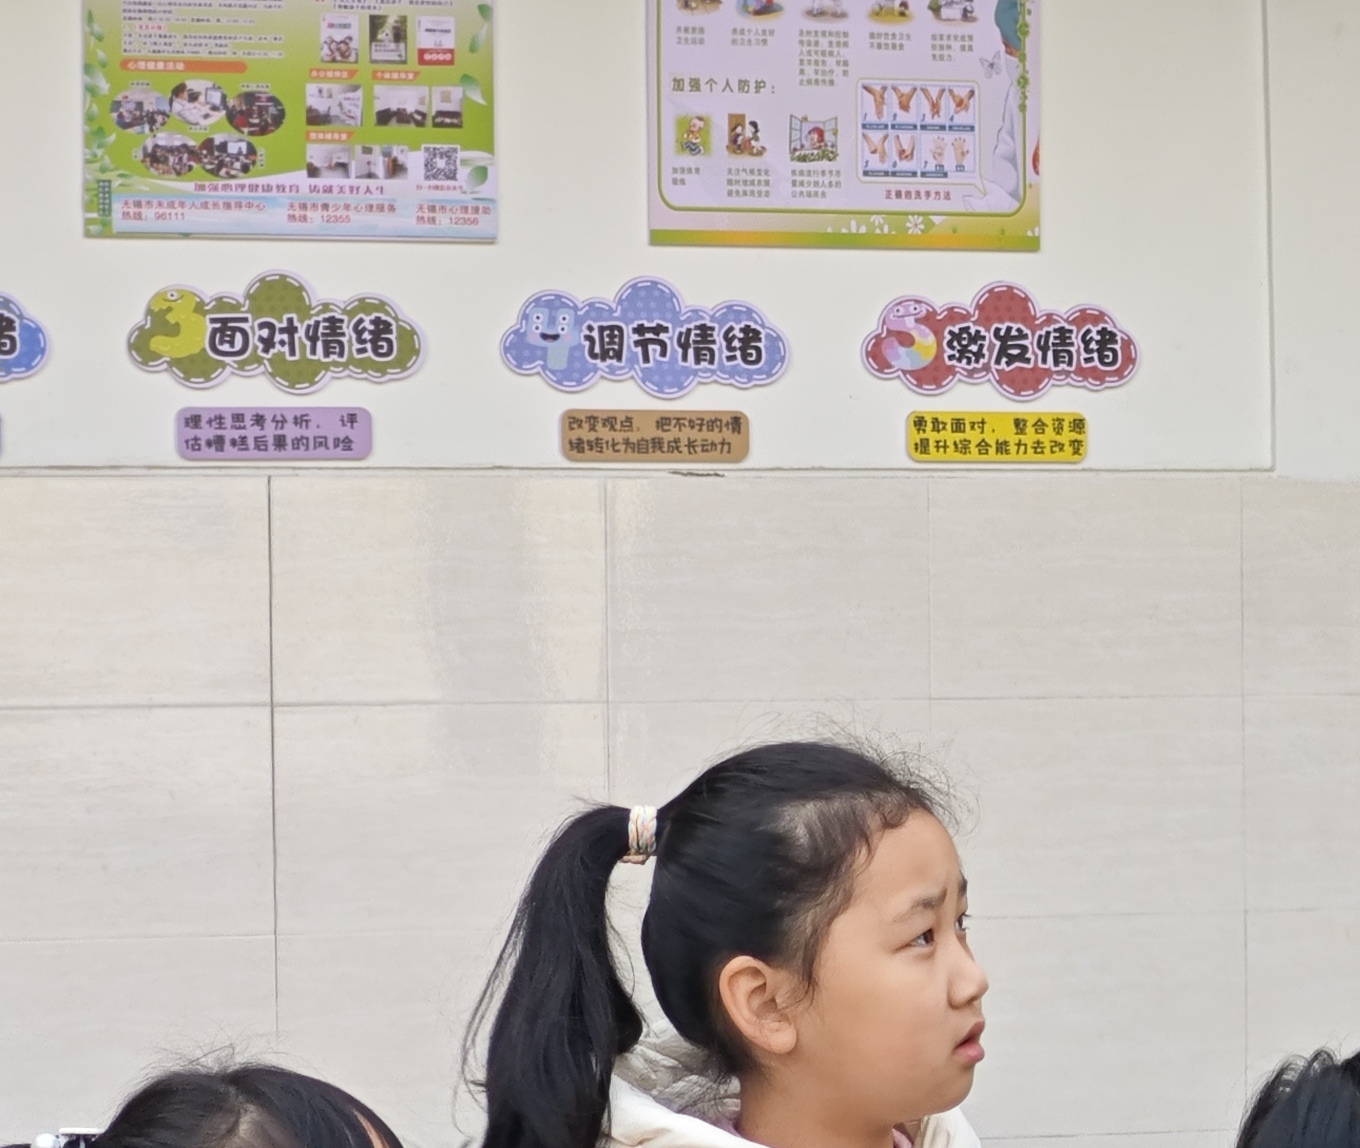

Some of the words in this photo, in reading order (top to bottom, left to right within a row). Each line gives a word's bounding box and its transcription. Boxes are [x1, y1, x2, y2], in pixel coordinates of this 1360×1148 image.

[121, 199, 266, 212] 无锡市未成年人成长指导中心
[207, 315, 395, 359] 面对情绪
[584, 322, 763, 367] 调节情绪
[945, 324, 1120, 369] 激发情绪
[184, 434, 354, 452] 估糟糕后果的风险
[568, 437, 732, 455] 绪转化为自我成长动力
[913, 437, 1085, 457] 提升综合能力去改变
